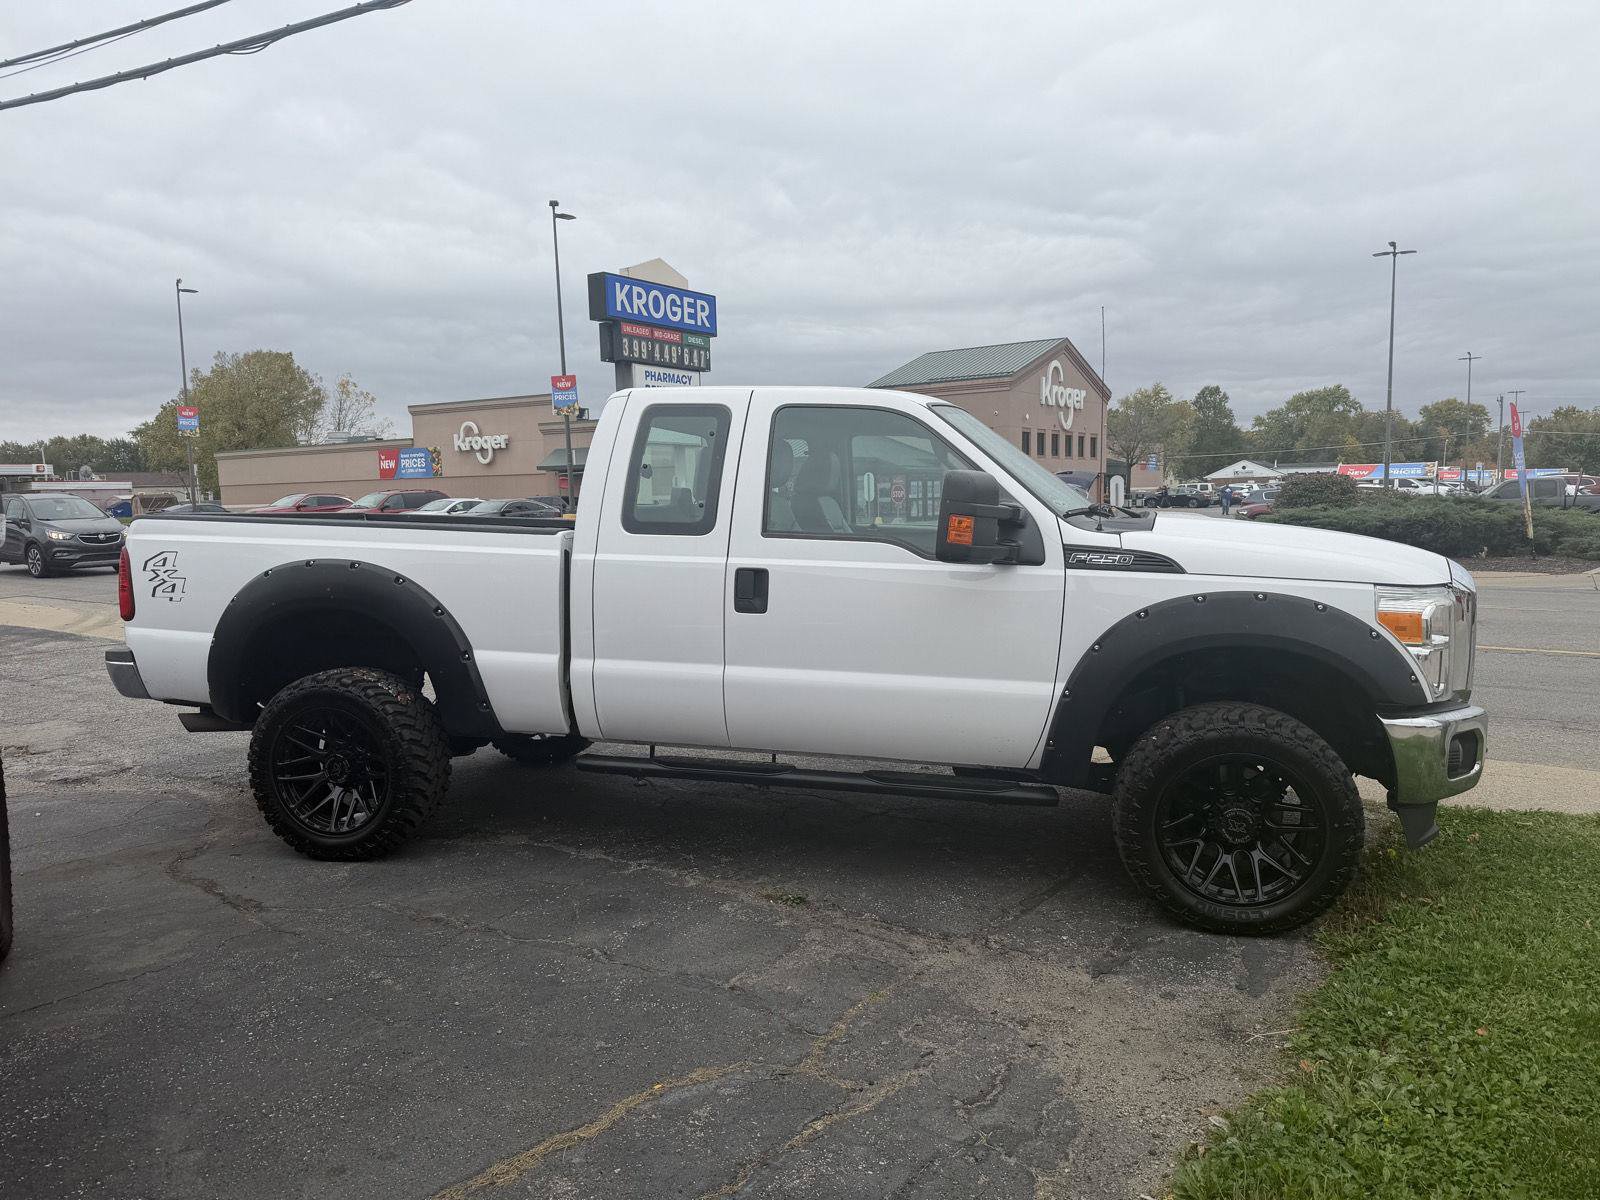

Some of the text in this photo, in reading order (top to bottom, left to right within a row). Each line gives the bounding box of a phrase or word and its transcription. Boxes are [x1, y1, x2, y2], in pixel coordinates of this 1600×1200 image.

[615, 282, 711, 328] KROGER
[623, 325, 650, 336] UNLEADED
[687, 336, 704, 345] DIESEL
[644, 370, 693, 386] PHARMACY
[556, 381, 572, 389] NEW
[1040, 359, 1087, 430] Kroger
[453, 421, 510, 465] Kroger
[380, 459, 396, 469] NEW
[400, 458, 426, 469] PRICES
[892, 490, 905, 498] STOP
